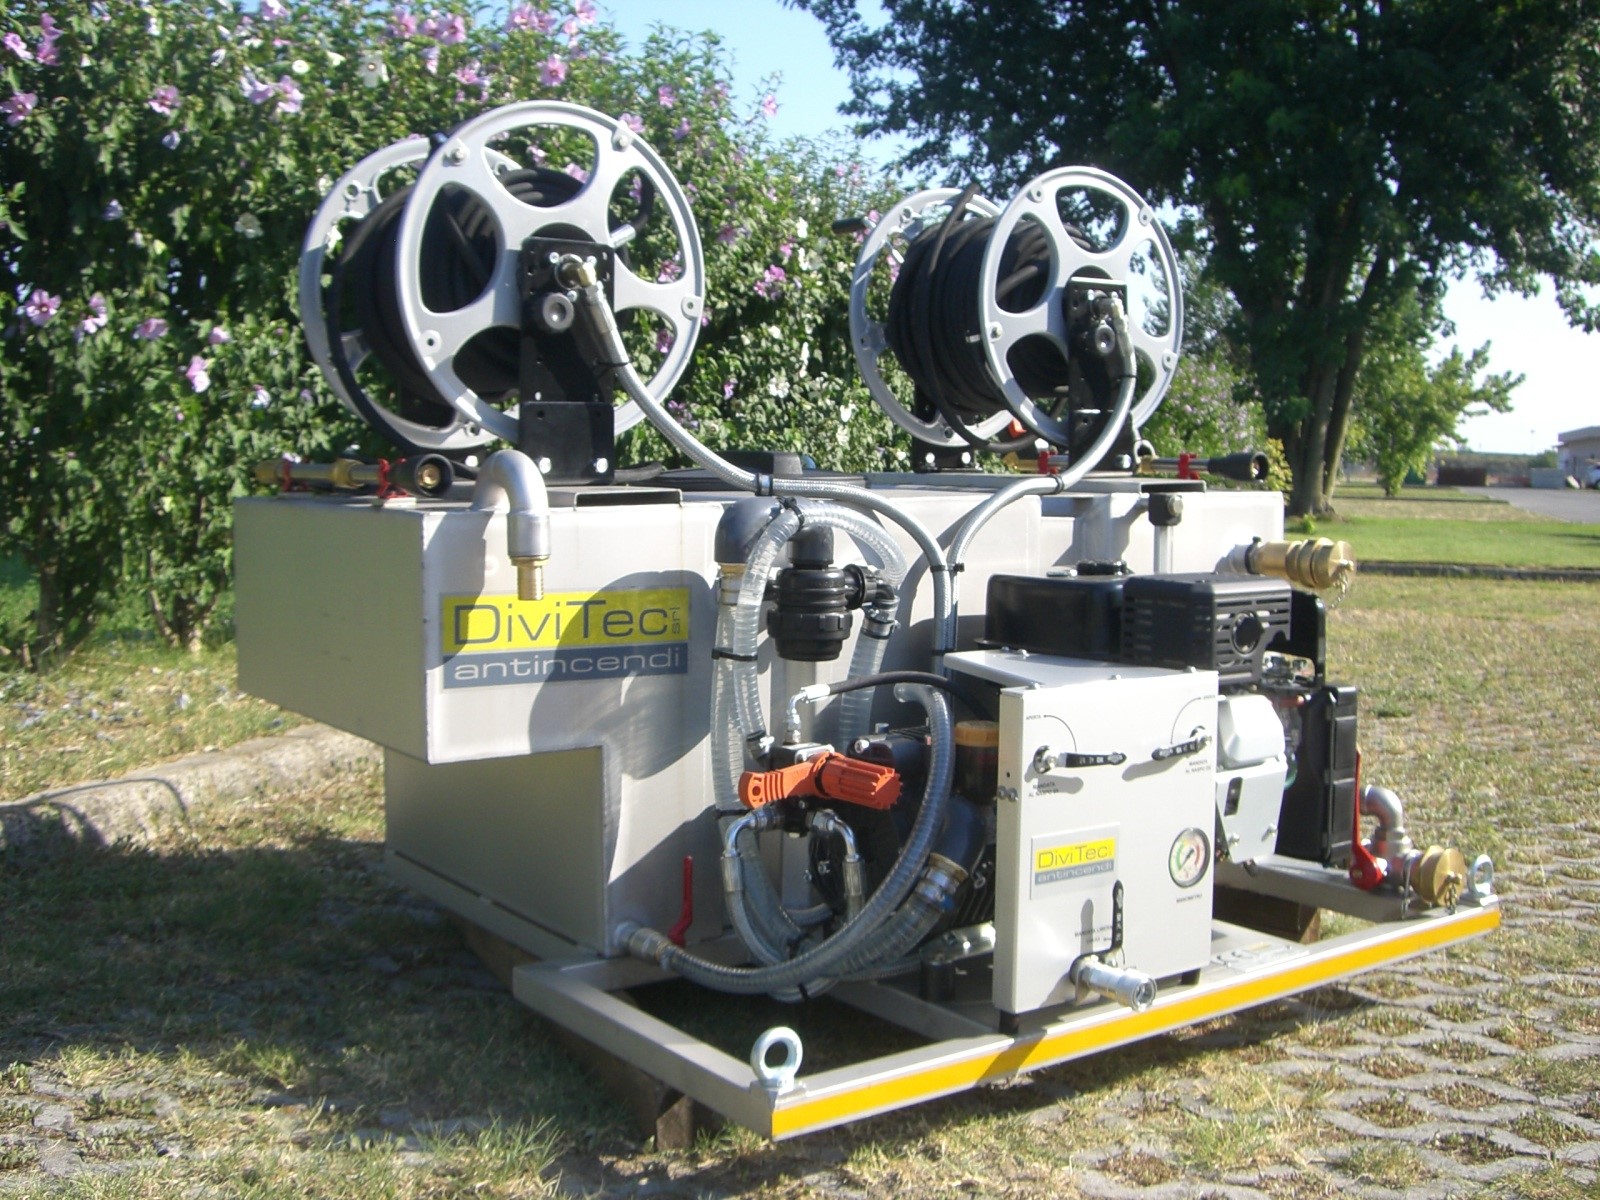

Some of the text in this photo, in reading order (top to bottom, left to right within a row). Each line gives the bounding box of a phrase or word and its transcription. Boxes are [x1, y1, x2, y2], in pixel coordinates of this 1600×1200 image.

[454, 599, 668, 645] DiviTec
[671, 606, 681, 635] srl
[454, 647, 680, 681] antincendi
[1038, 845, 1107, 869] DiviTec
[1038, 861, 1112, 882] antincendi
